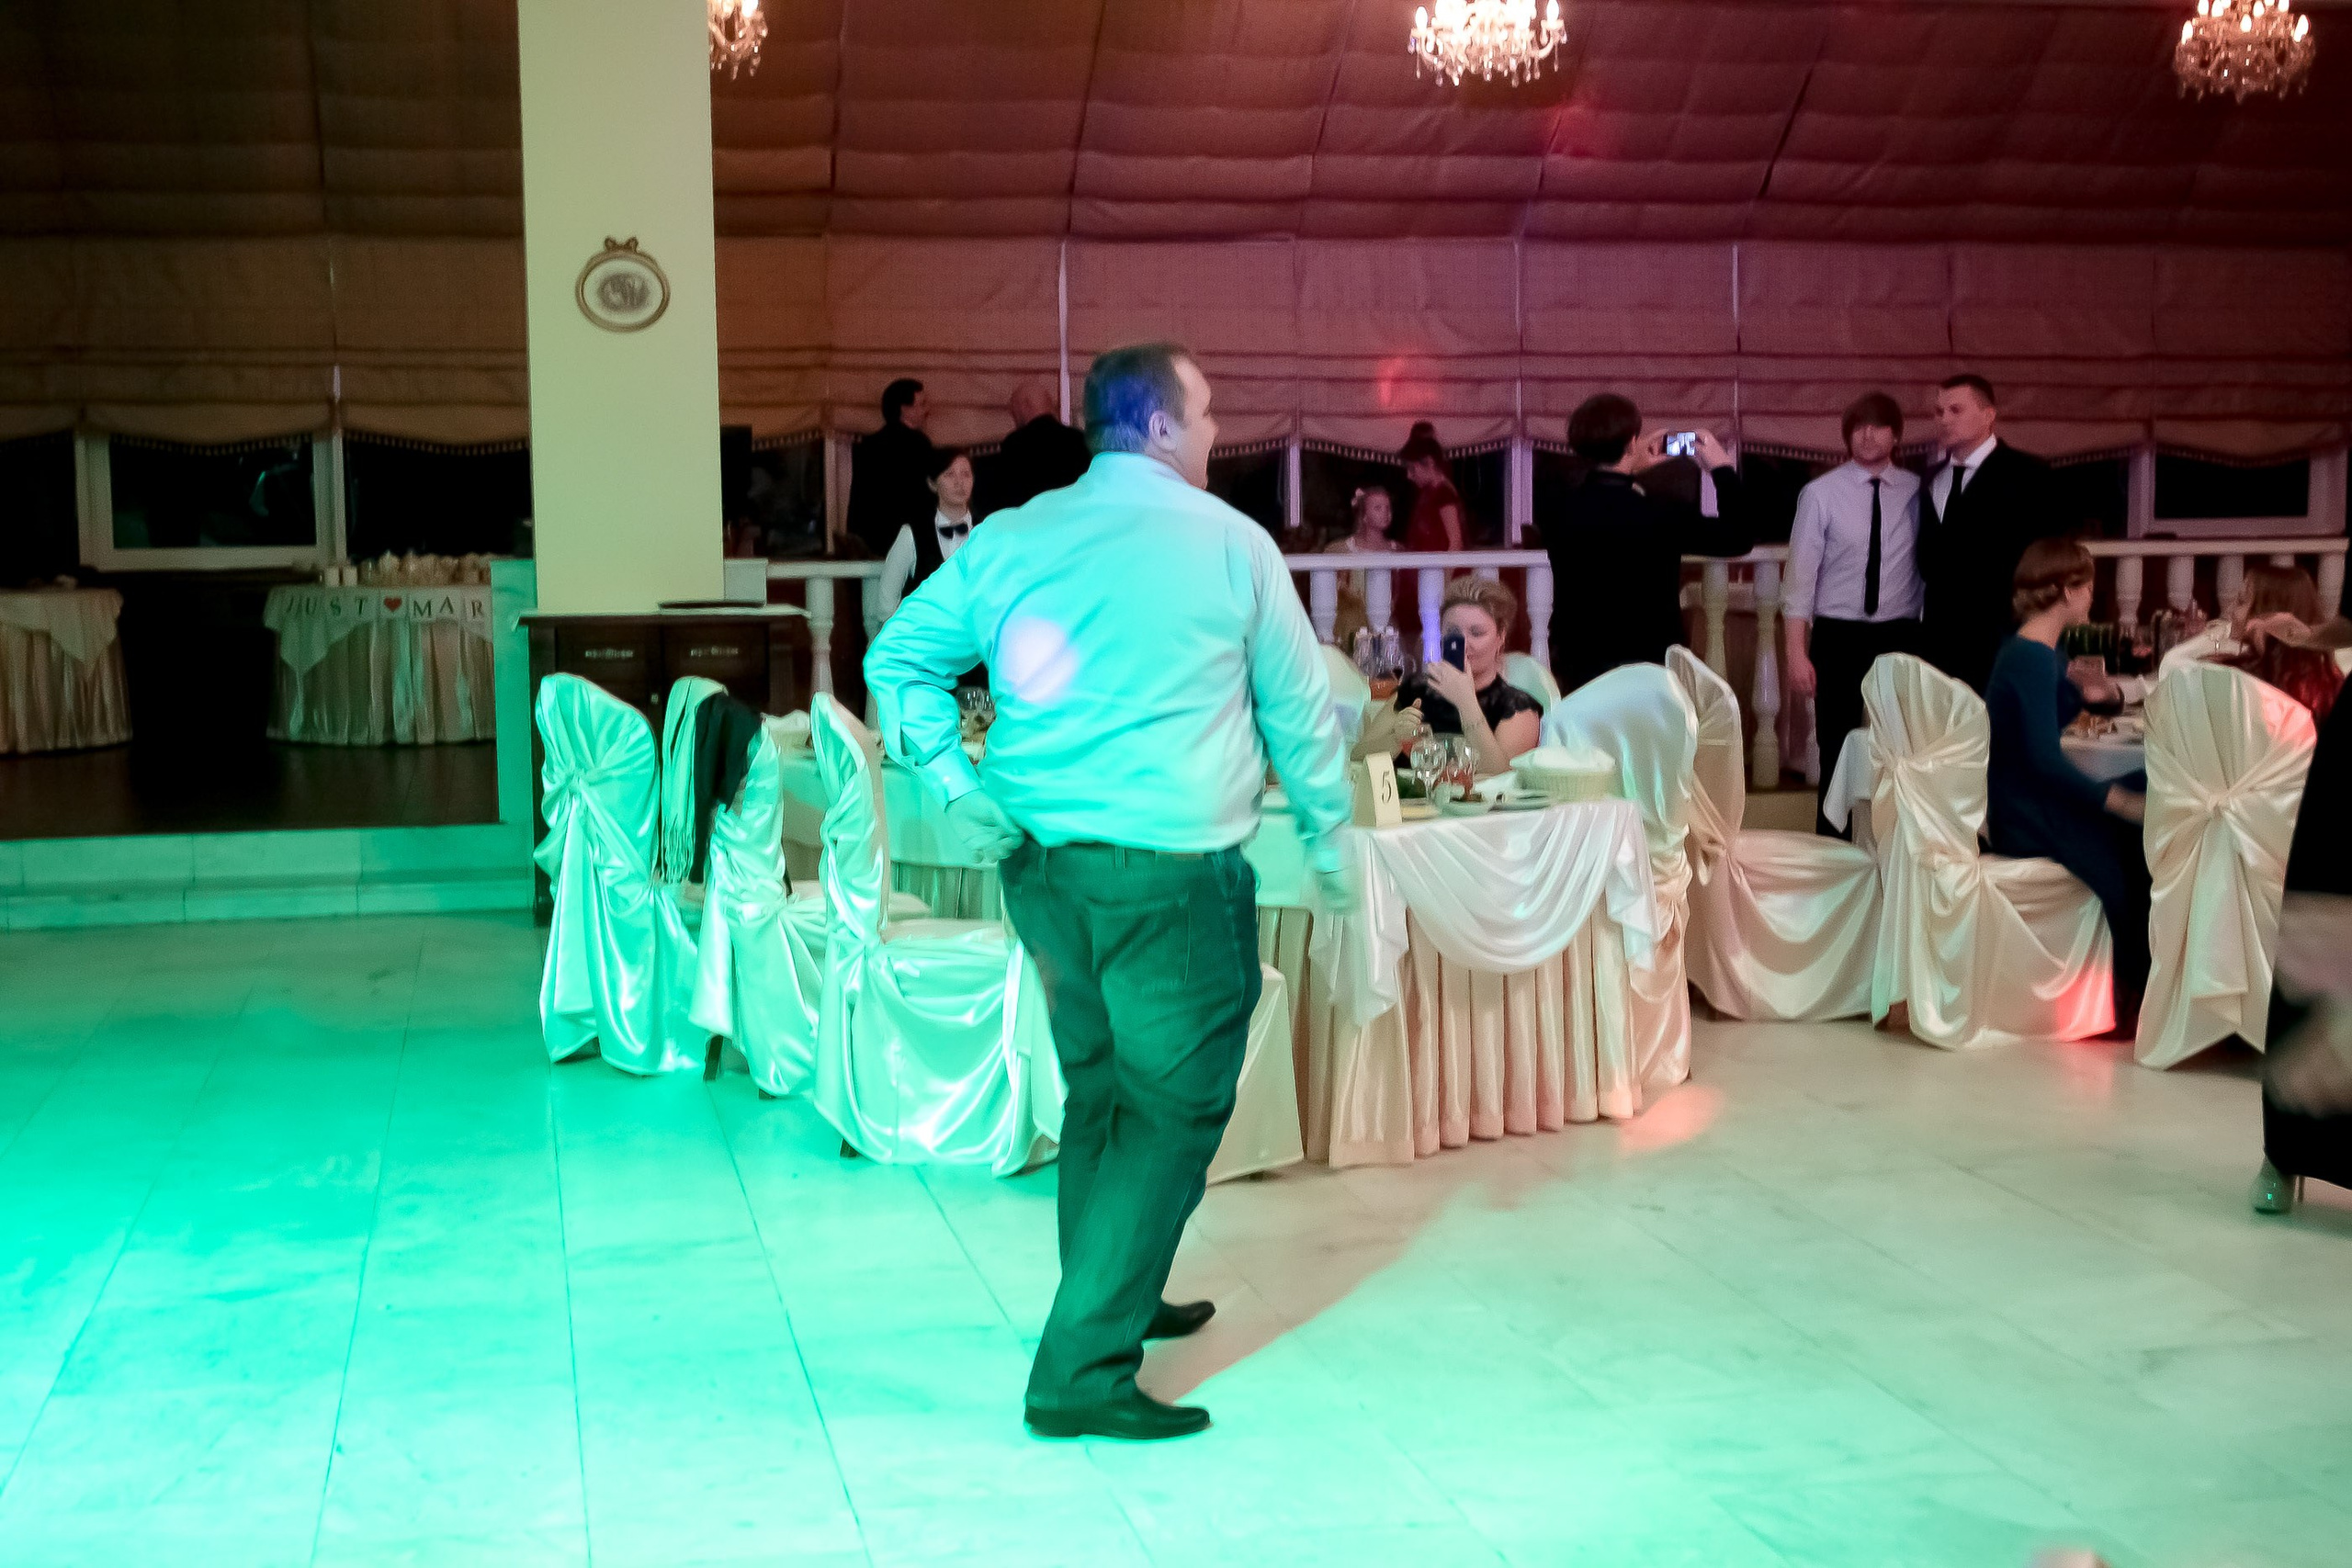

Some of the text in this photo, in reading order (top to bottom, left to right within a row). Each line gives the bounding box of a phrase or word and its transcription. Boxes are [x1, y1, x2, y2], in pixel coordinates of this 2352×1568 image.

[286, 595, 483, 617] JUST MAR
[1381, 771, 1392, 804] 5
